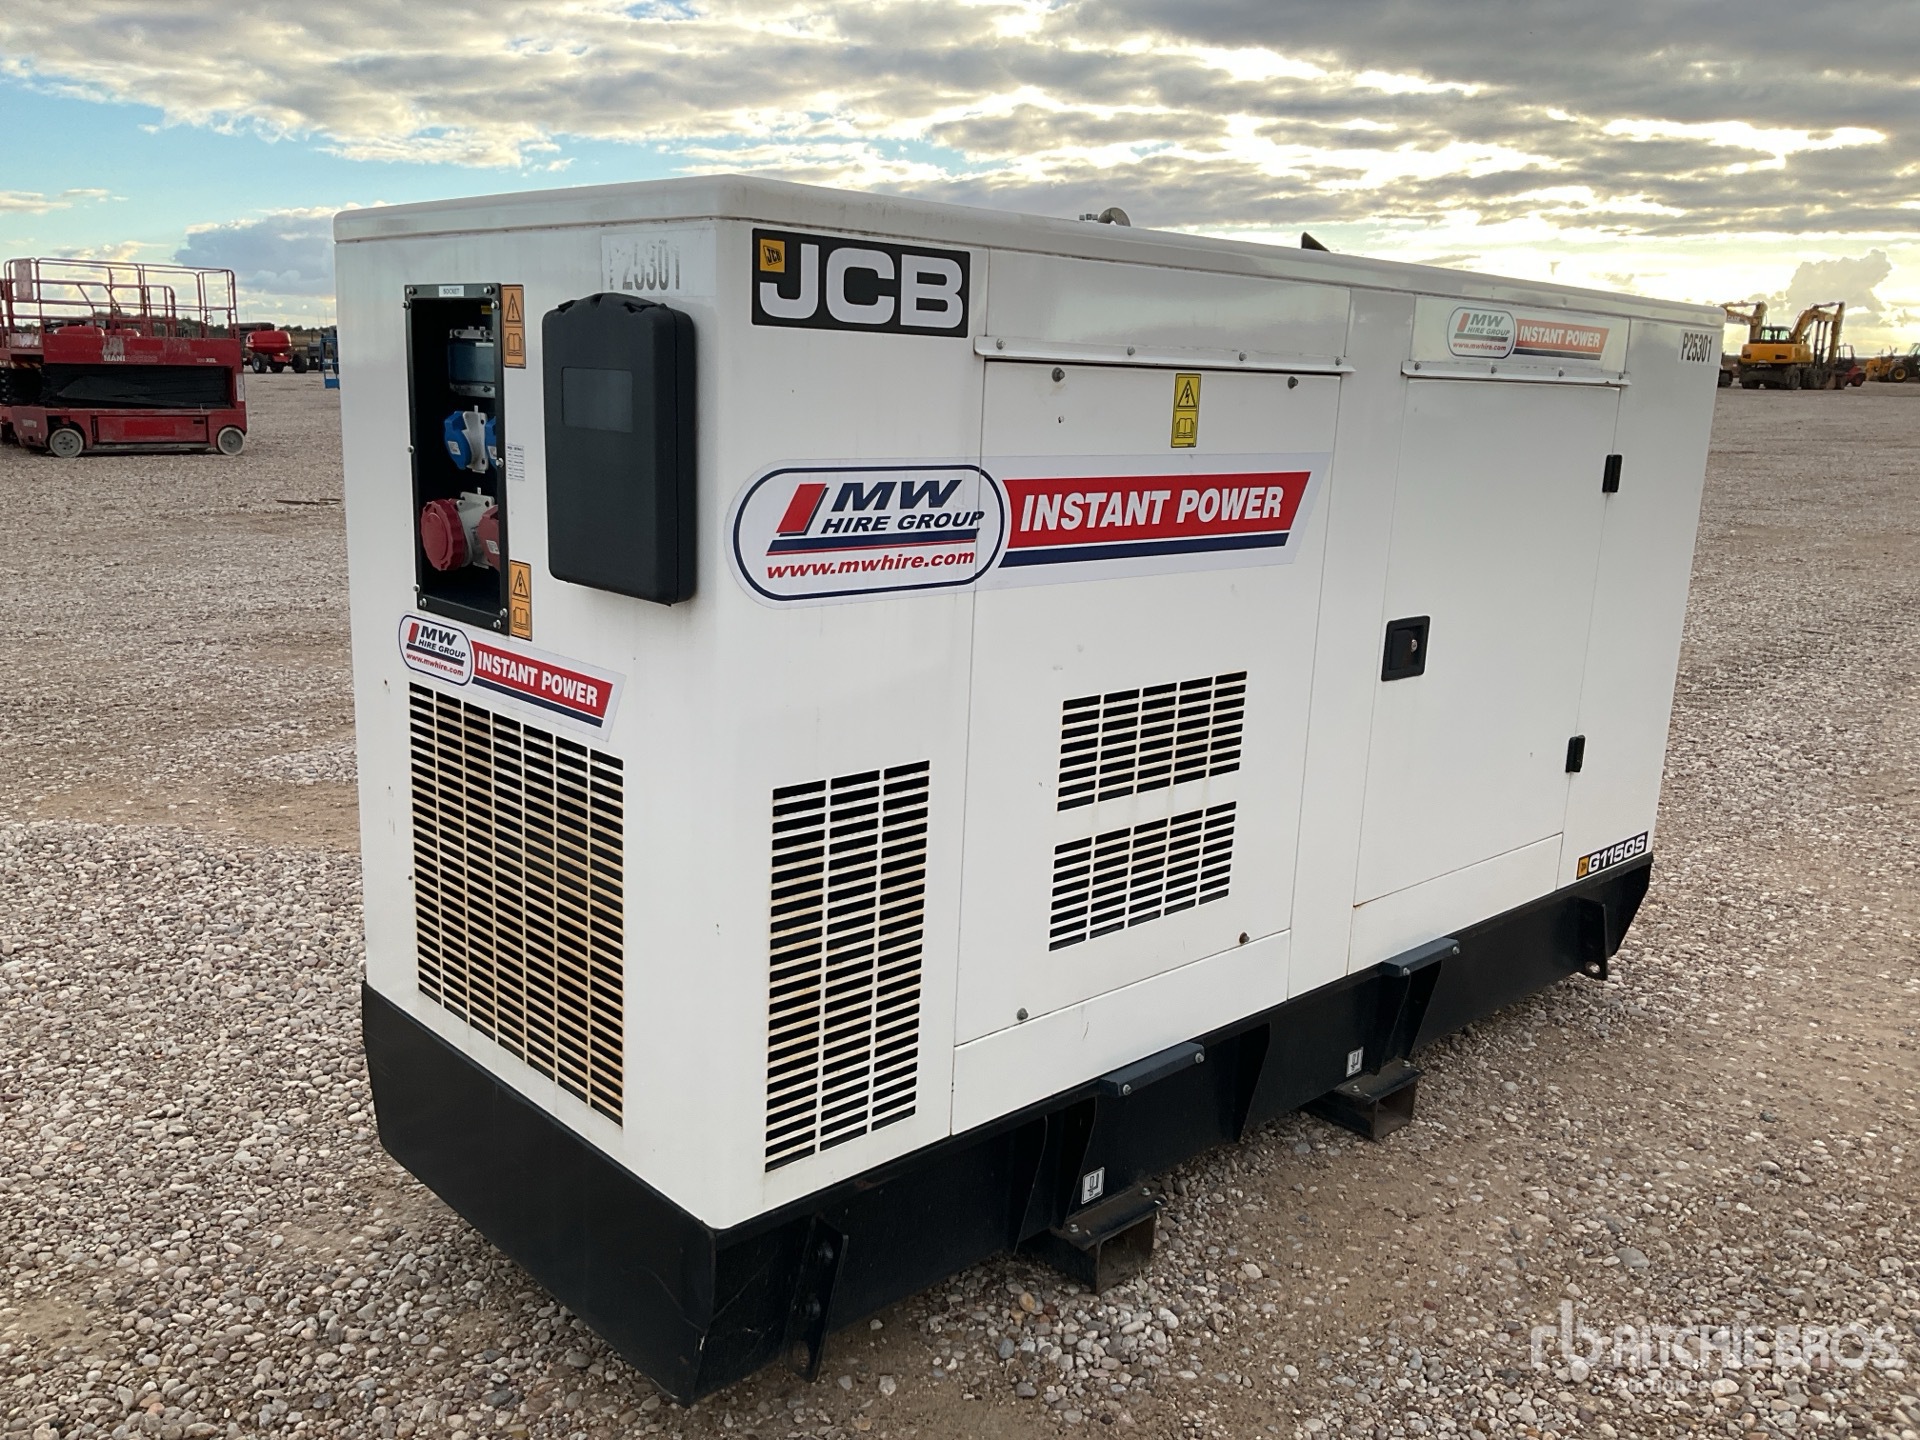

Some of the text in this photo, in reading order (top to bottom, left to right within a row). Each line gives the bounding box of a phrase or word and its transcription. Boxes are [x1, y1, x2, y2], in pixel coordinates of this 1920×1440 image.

[759, 243, 963, 329] JCB
[1470, 313, 1505, 327] MW
[1486, 328, 1510, 336] GROUP
[1519, 325, 1601, 347] INSTANT POWER
[1681, 332, 1713, 362] P25301
[831, 480, 962, 512] MW
[1019, 486, 1284, 532] INSTANT POWER
[820, 510, 985, 534] HIRE GROUP
[766, 551, 975, 578] www.mwhire.com
[420, 625, 457, 646] MW
[418, 639, 466, 658] HIRE GROUP
[406, 653, 464, 676] www.mwhire.com
[477, 651, 598, 708] INSTANT POWER
[1588, 834, 1646, 872] G115QS
